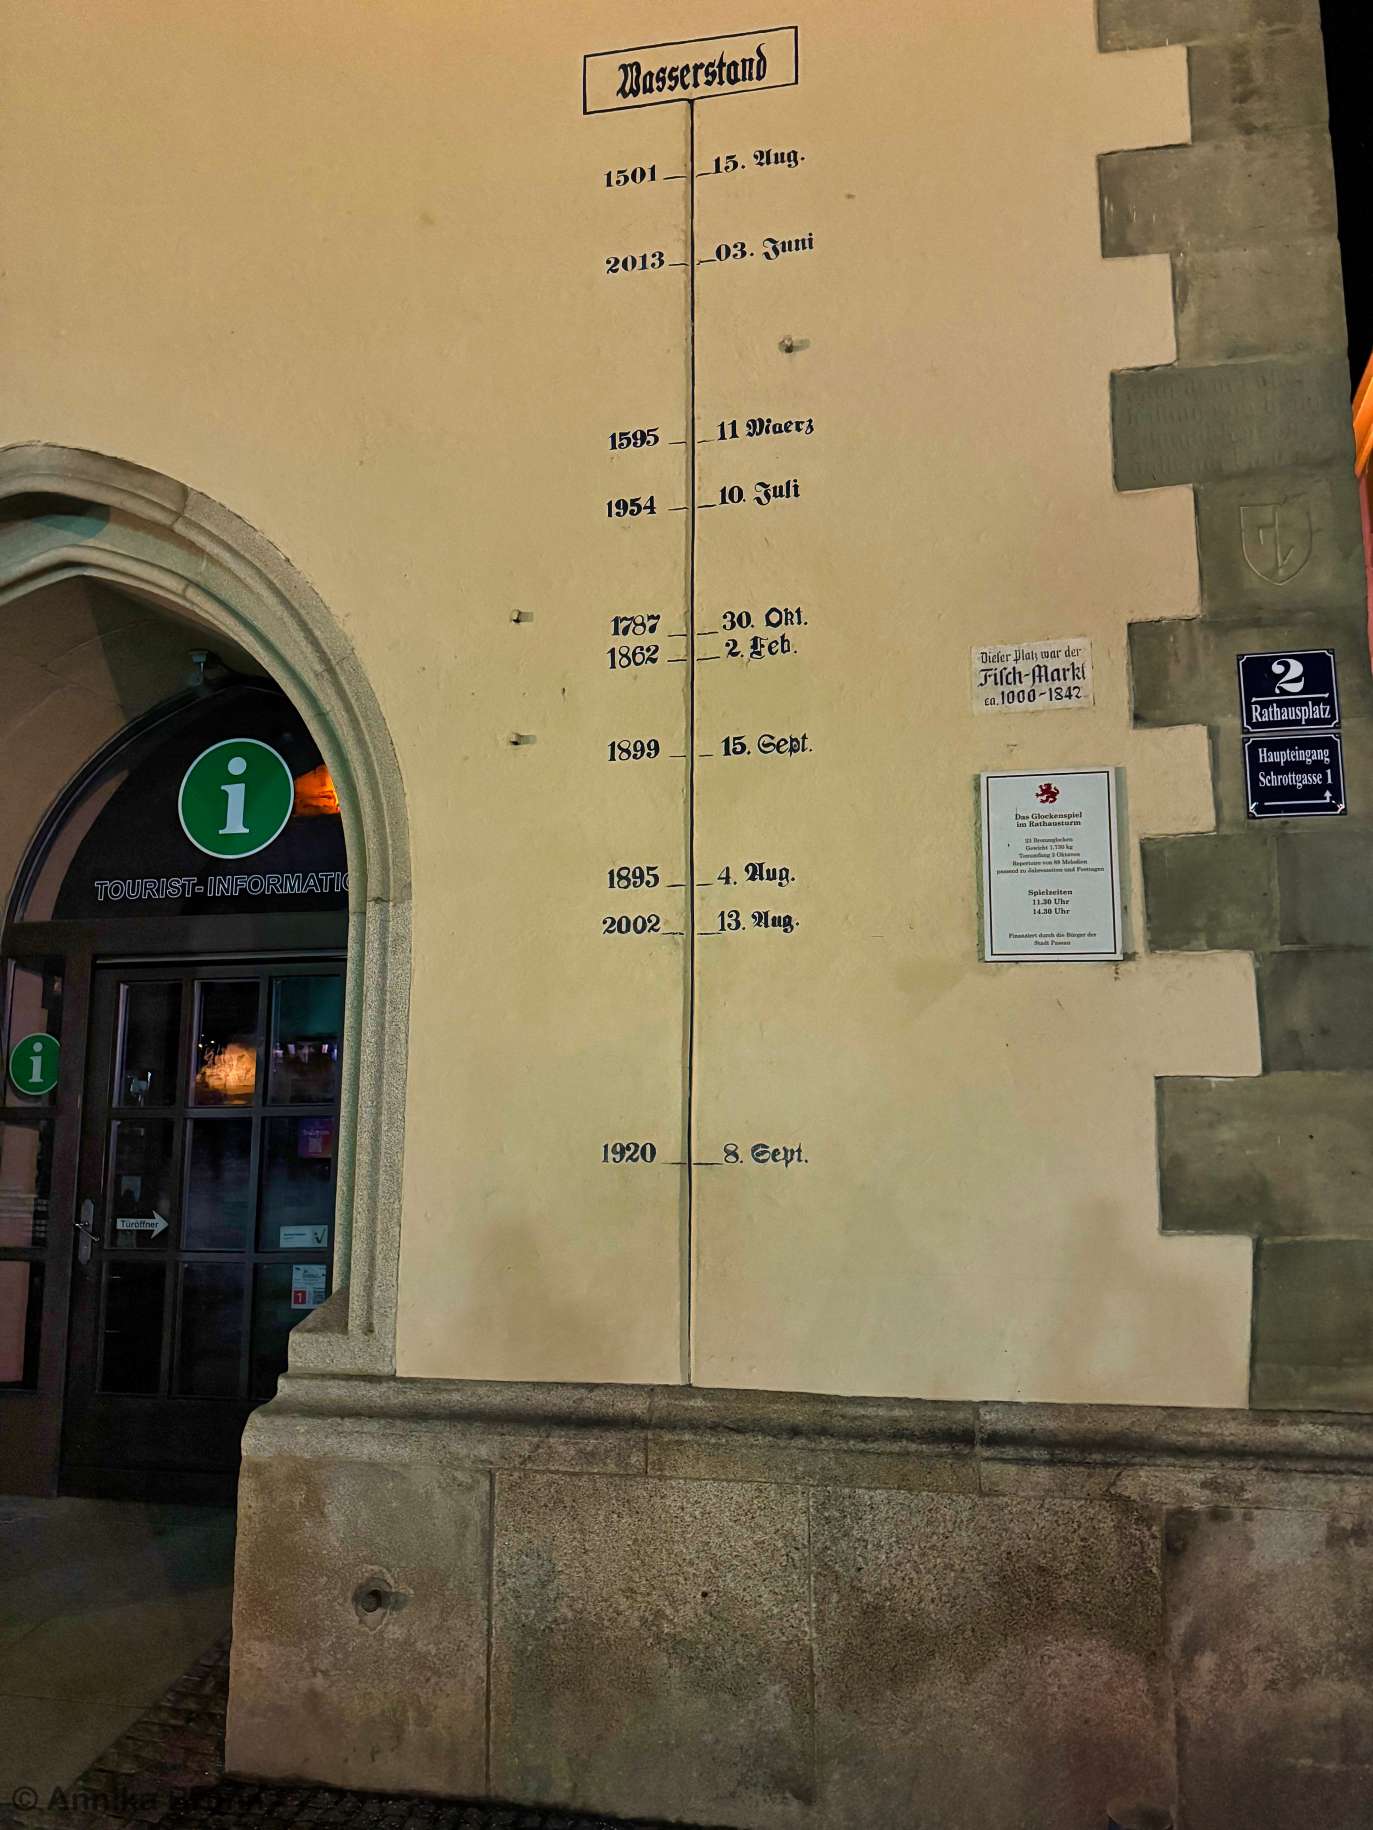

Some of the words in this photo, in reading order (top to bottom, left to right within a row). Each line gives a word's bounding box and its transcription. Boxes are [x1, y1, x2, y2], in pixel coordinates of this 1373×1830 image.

[617, 43, 767, 99] Wasserstand
[712, 154, 746, 174] 15.
[753, 148, 805, 169] Aug.
[604, 164, 656, 187] 1501
[715, 241, 755, 262] 03.
[762, 232, 814, 261] Juni
[605, 251, 665, 274] 2013
[608, 427, 660, 451] 1595
[717, 419, 740, 441] 11
[745, 417, 815, 438] Maerz
[719, 485, 746, 505] 10.
[753, 478, 801, 506] Juli
[606, 496, 657, 518] 1954
[610, 614, 661, 637] 1787
[722, 610, 755, 631] 30.
[765, 606, 808, 628] Okt.
[606, 644, 659, 670] 1862
[725, 638, 744, 658] 2.
[749, 632, 798, 660] Feb.
[1013, 649, 1038, 665] Platz
[1041, 649, 1061, 659] war
[1065, 645, 1082, 658] der
[1271, 658, 1305, 694] 2
[1251, 701, 1331, 725] Rathausplatz
[607, 738, 660, 762] 1899
[721, 735, 751, 757] 15.
[757, 732, 813, 758] Sept.
[1258, 746, 1330, 766] Haupteingang
[1258, 771, 1323, 789] Schrottgasse
[1325, 769, 1333, 784] 1
[1029, 820, 1081, 828] Rathausturm
[1031, 811, 1083, 820] Glockenspiel
[607, 865, 660, 889] 1895
[717, 866, 737, 886] 4.
[744, 862, 795, 887] Aug.
[1028, 888, 1073, 897] Spielzeiten
[717, 909, 746, 932] 13.
[751, 910, 800, 934] Aug.
[1054, 907, 1070, 915] Uhr
[602, 913, 661, 935] 2002
[601, 1142, 657, 1164] 1920
[723, 1142, 744, 1164] 8.
[751, 1142, 809, 1168] Sept.
